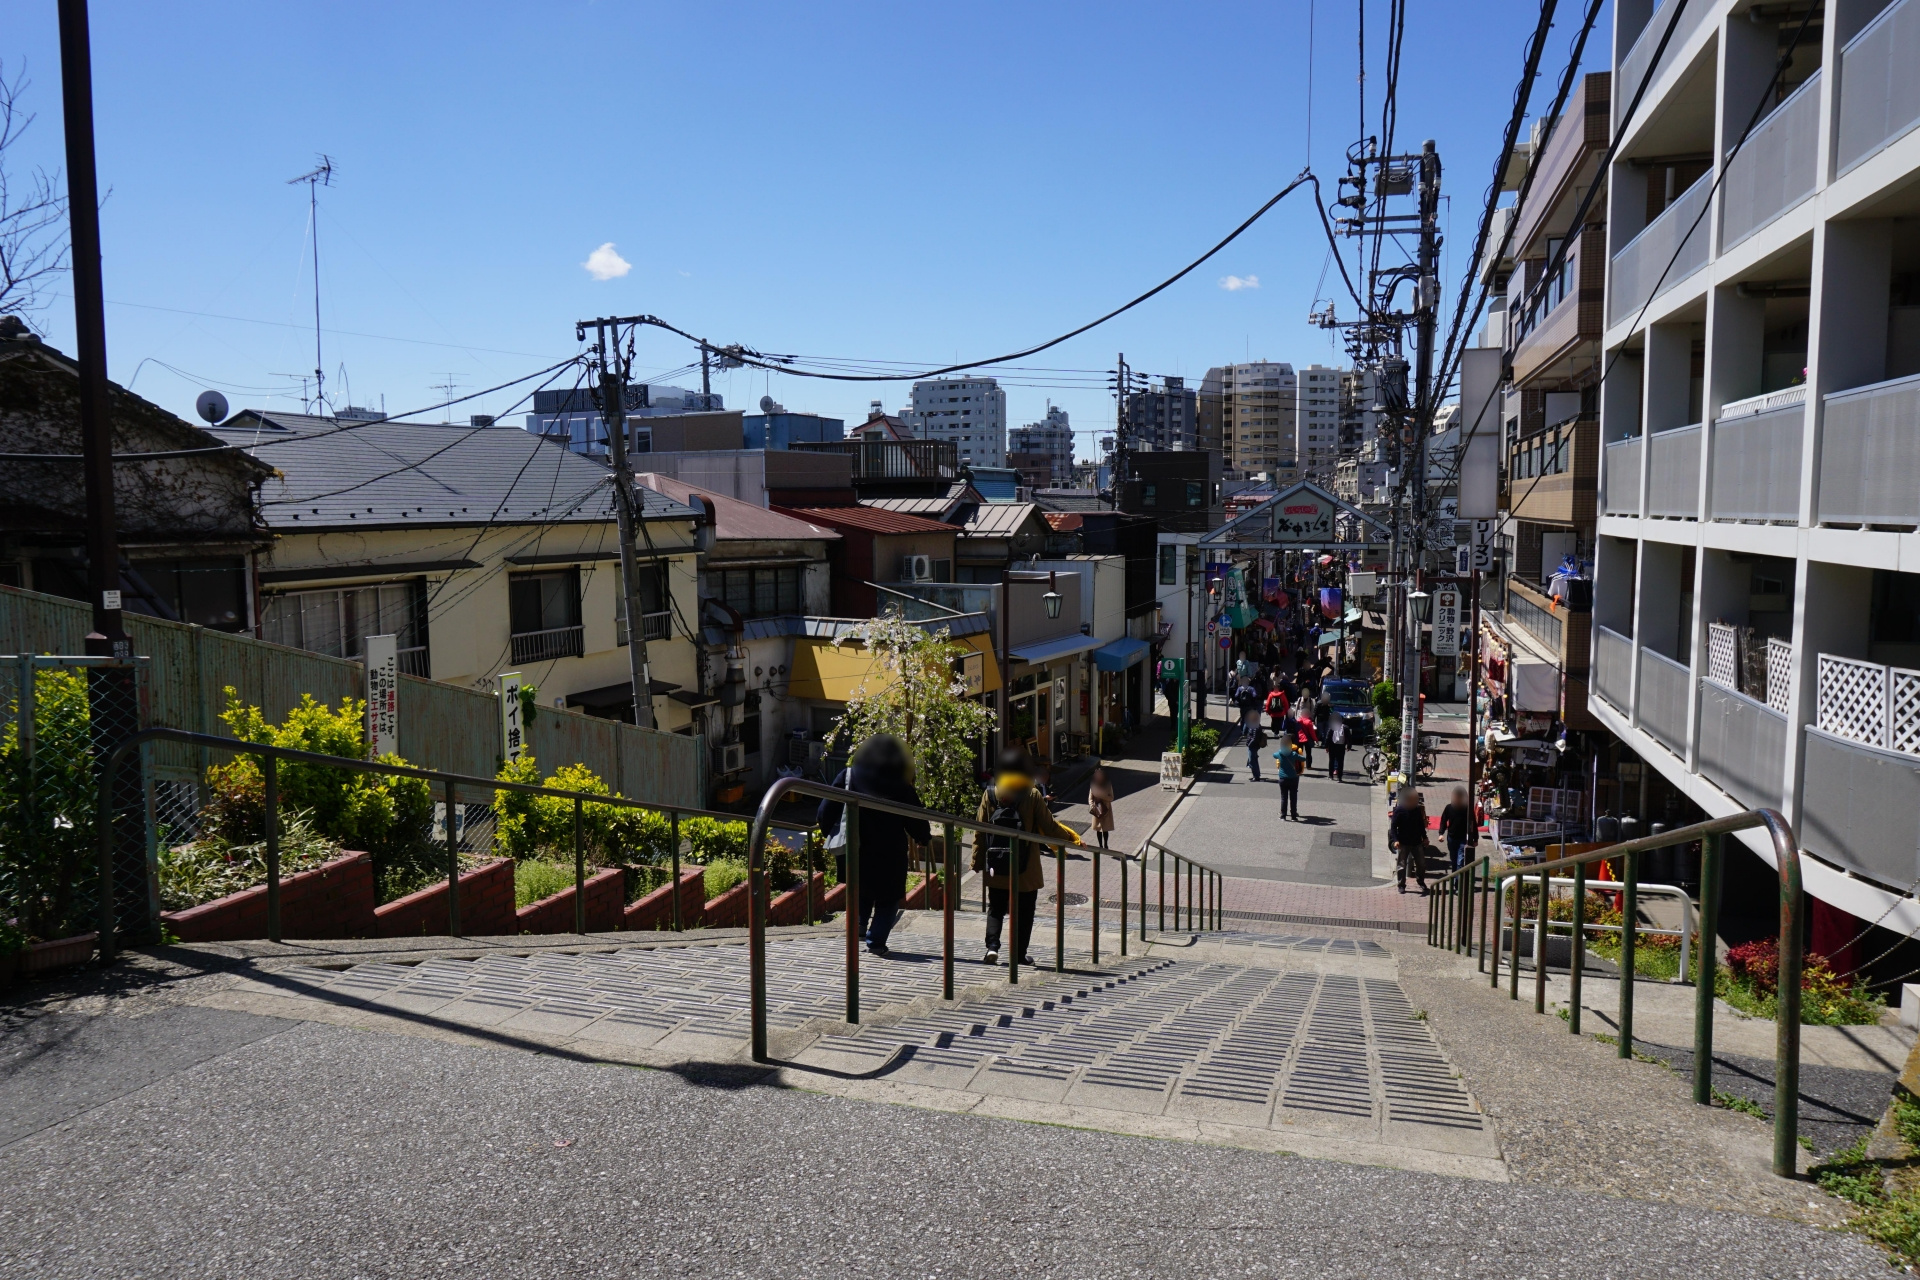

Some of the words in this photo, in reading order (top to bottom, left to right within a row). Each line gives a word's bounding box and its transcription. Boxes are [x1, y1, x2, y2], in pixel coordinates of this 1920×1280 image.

[1277, 513, 1330, 537] 谷中ぎんざ
[1475, 519, 1490, 567] リーマン
[1437, 608, 1446, 642] クリニック
[1446, 607, 1456, 643] 動物・野沢
[370, 669, 379, 762] 動物にエサを与え
[378, 667, 388, 736] この場所では、
[506, 684, 521, 764] ポイ捨て
